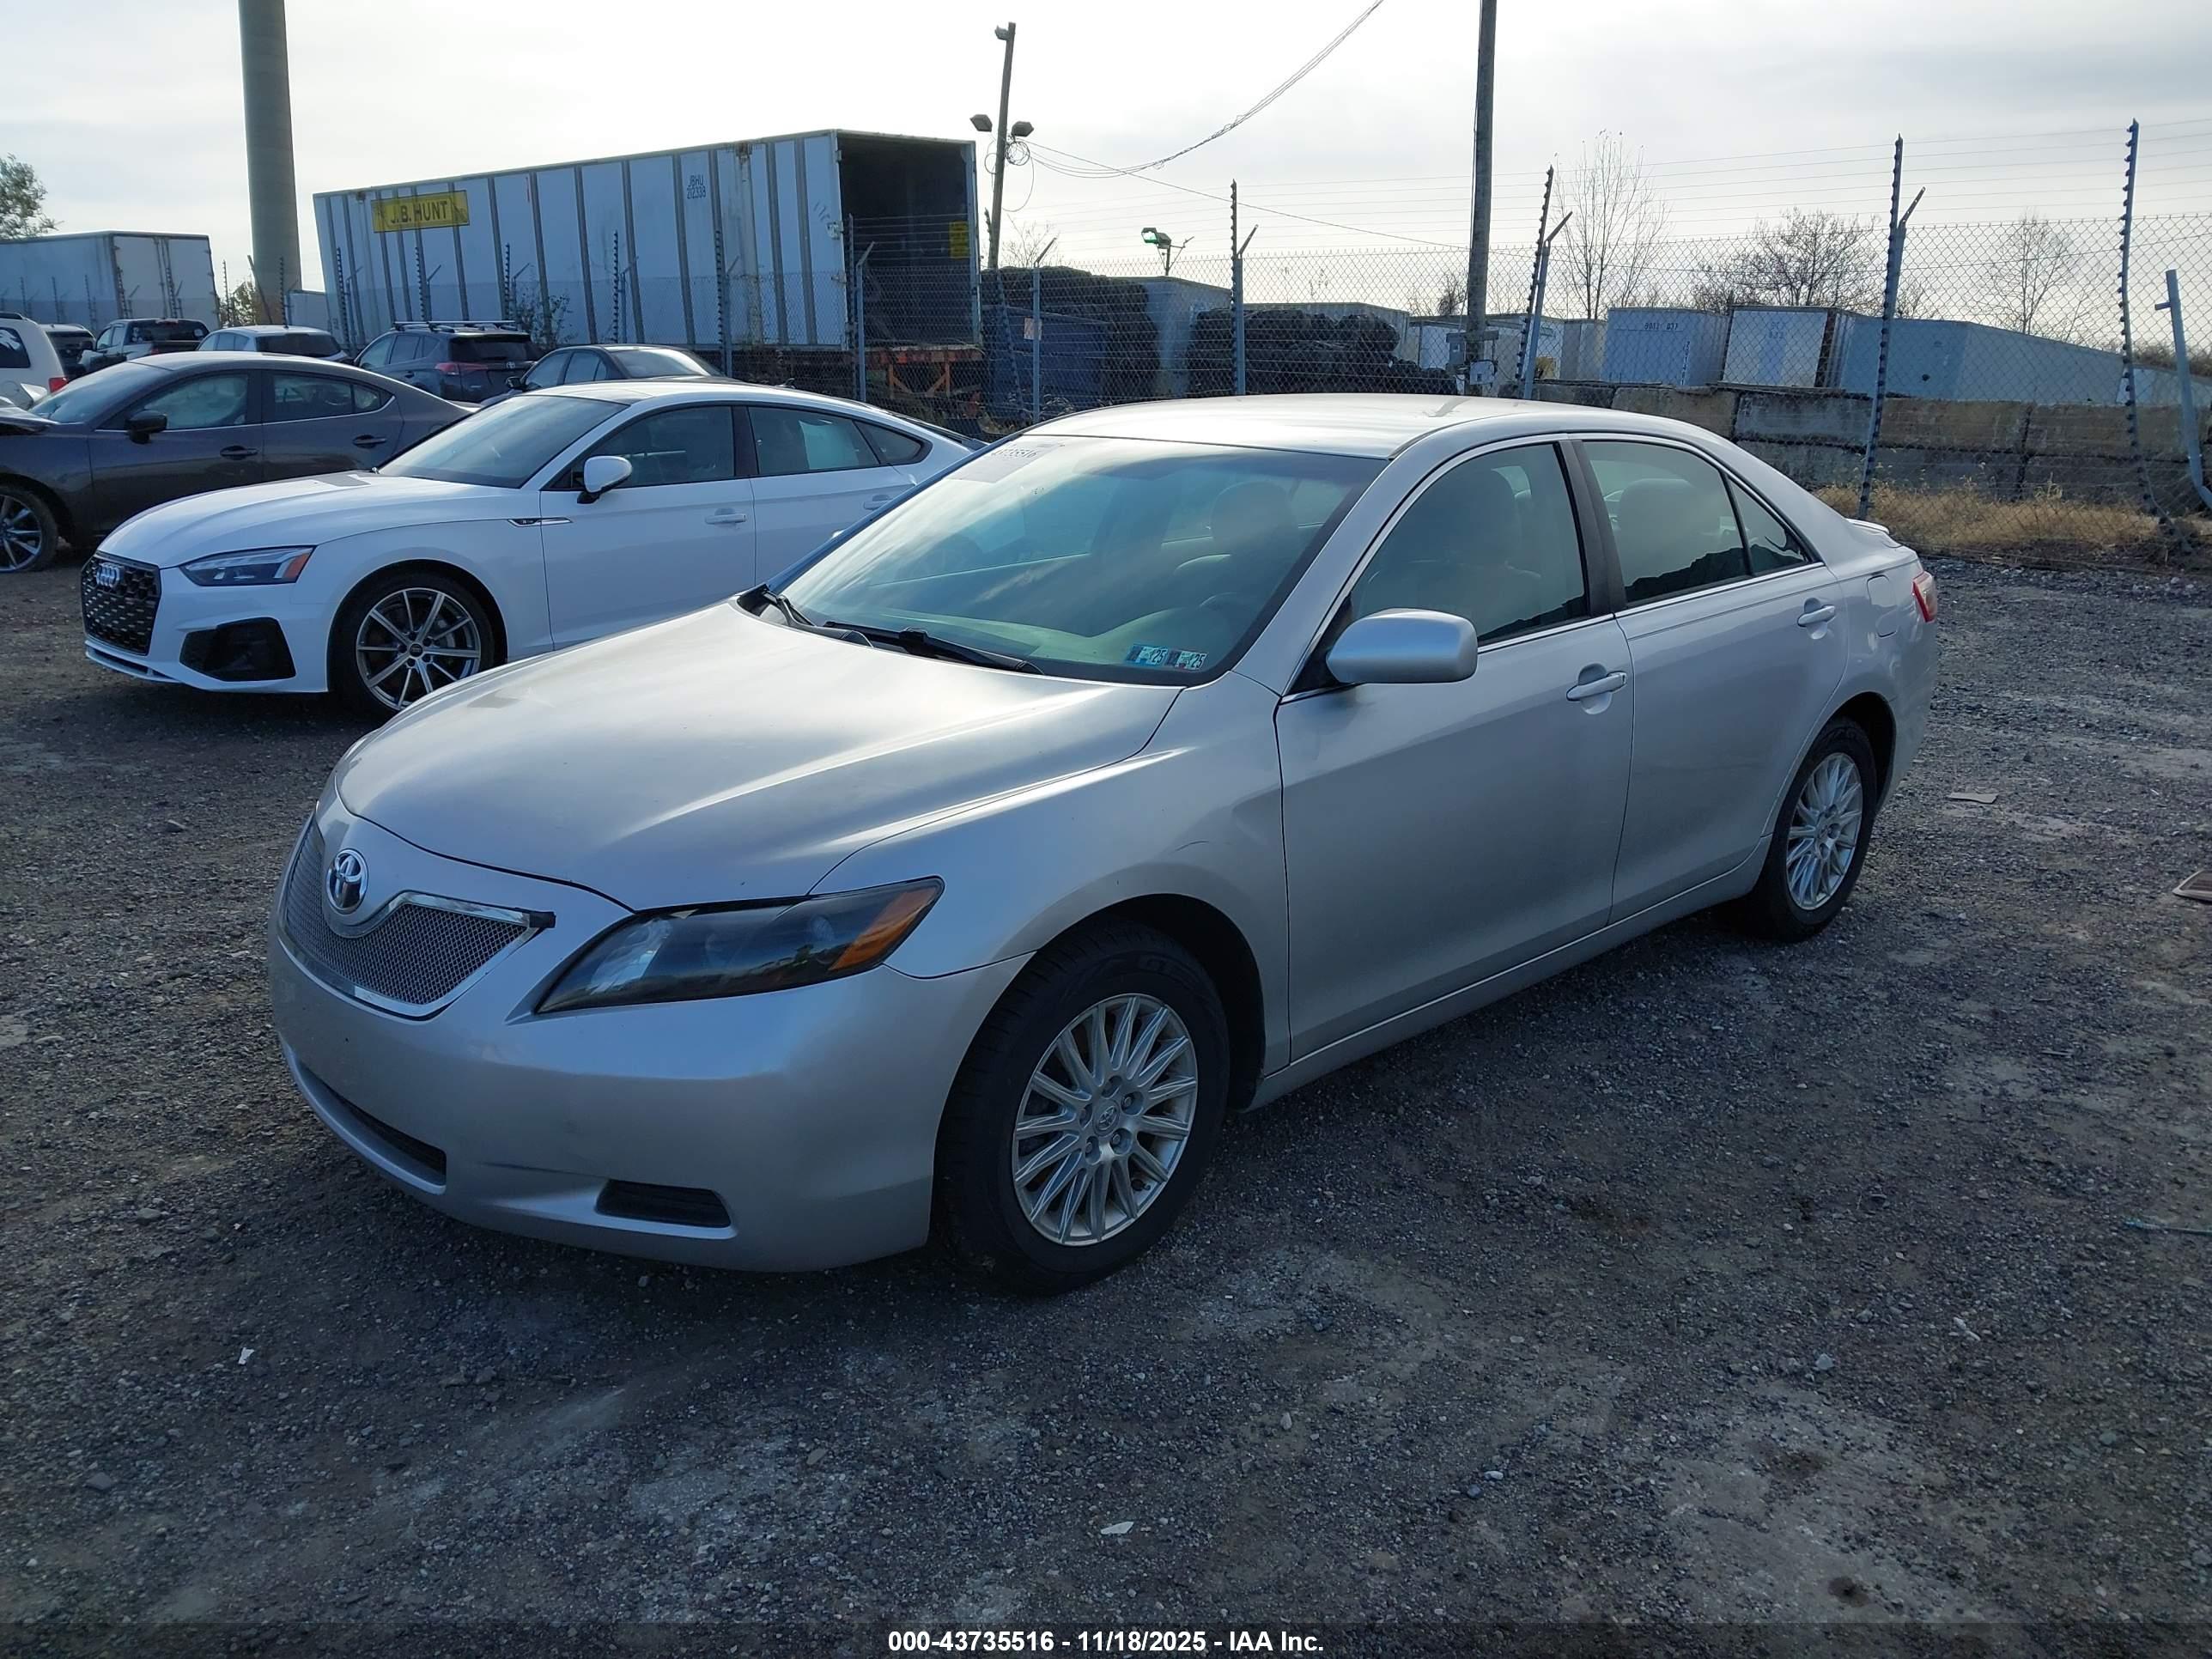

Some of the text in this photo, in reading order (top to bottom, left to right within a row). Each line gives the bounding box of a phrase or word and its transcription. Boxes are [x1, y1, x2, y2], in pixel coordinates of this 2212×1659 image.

[390, 200, 448, 224] J.B. HUNT
[1152, 649, 1167, 664] 25
[1191, 653, 1206, 668] 25
